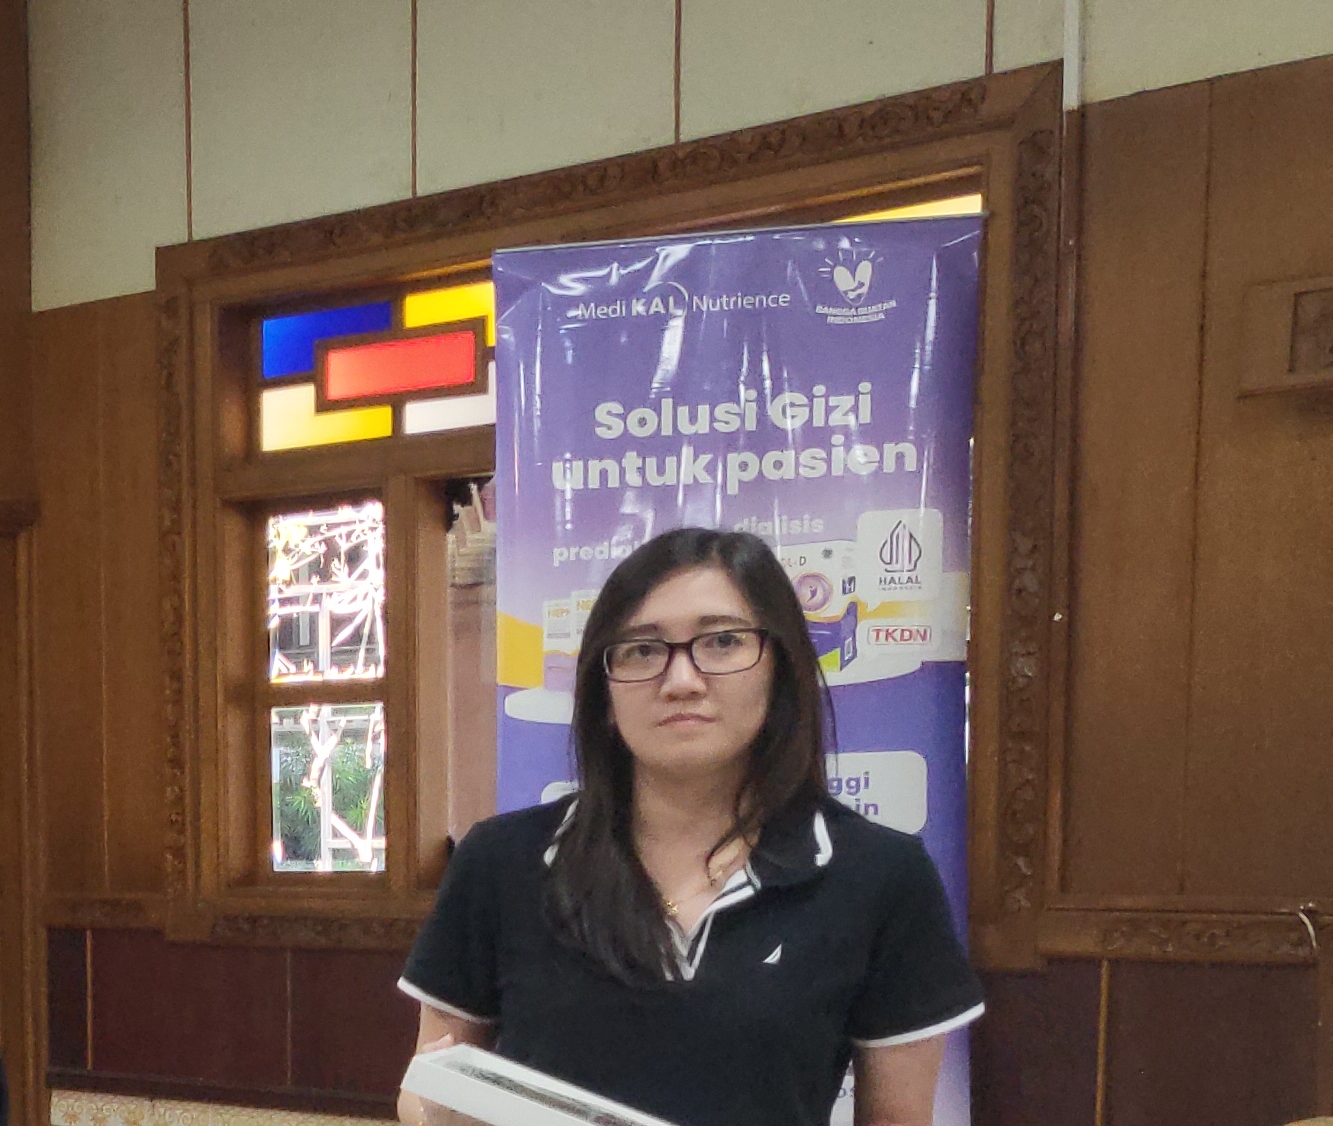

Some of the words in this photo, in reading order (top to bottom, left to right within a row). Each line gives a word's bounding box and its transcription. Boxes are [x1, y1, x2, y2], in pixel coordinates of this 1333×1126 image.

[693, 293, 791, 312] Nutrience
[594, 389, 758, 440] Solusi
[770, 382, 872, 431] Gizi
[552, 446, 714, 491] untuk
[727, 435, 918, 495] pasien
[879, 574, 921, 586] HALAL
[871, 627, 928, 642] TKDN
